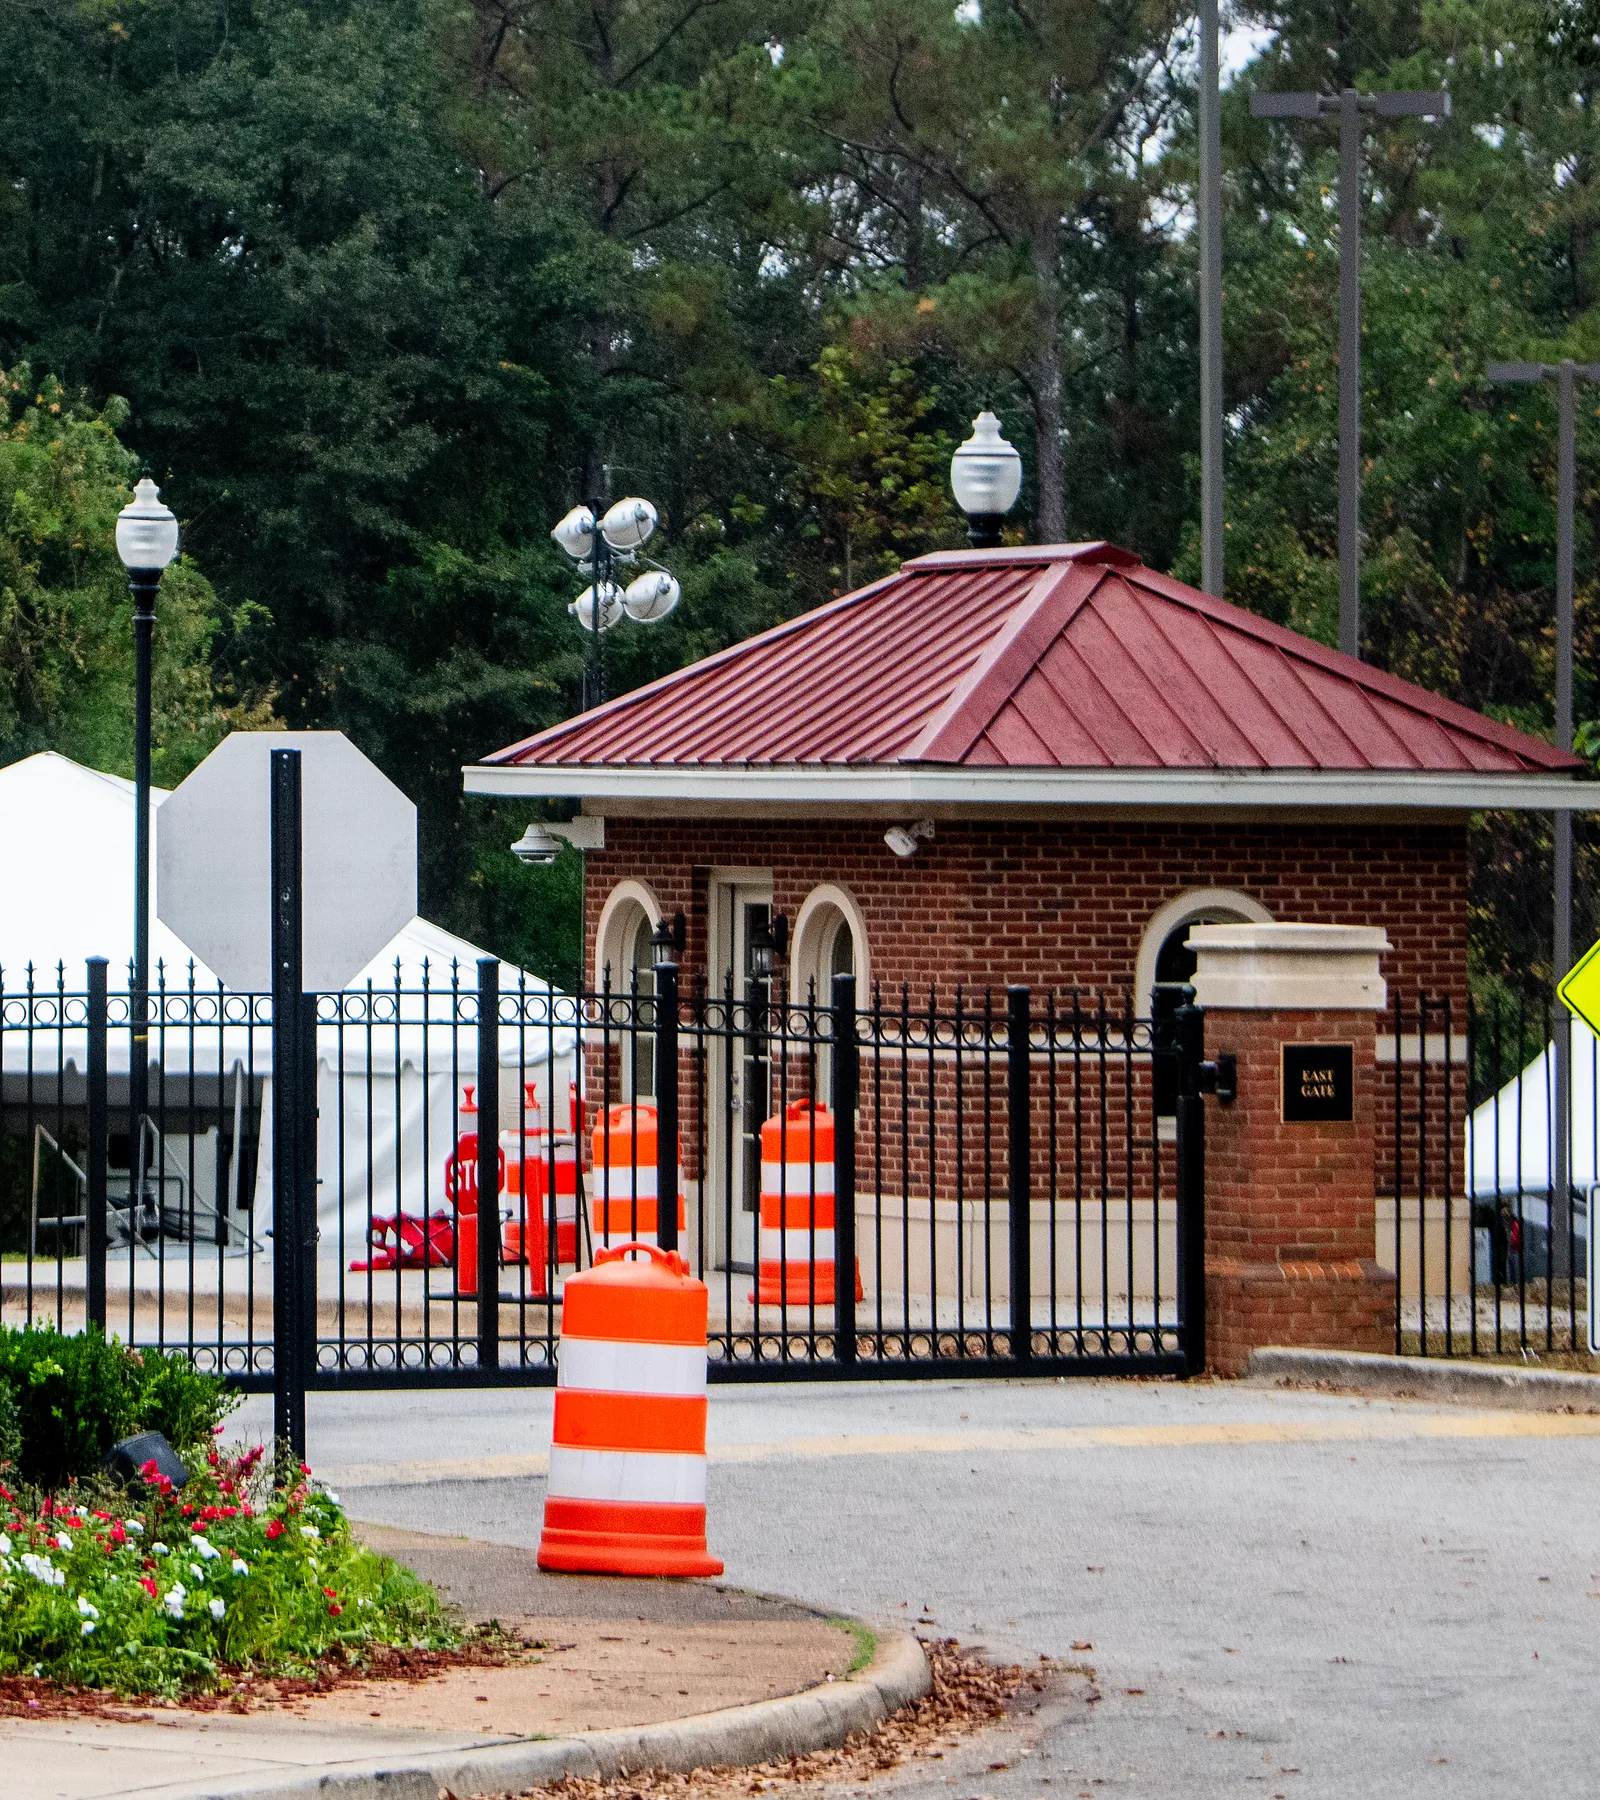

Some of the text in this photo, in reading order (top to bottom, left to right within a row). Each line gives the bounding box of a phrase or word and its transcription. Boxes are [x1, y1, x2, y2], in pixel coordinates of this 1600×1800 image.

[1302, 1069, 1334, 1083] EAST
[1301, 1084, 1336, 1098] GATE
[449, 1158, 502, 1193] ST
